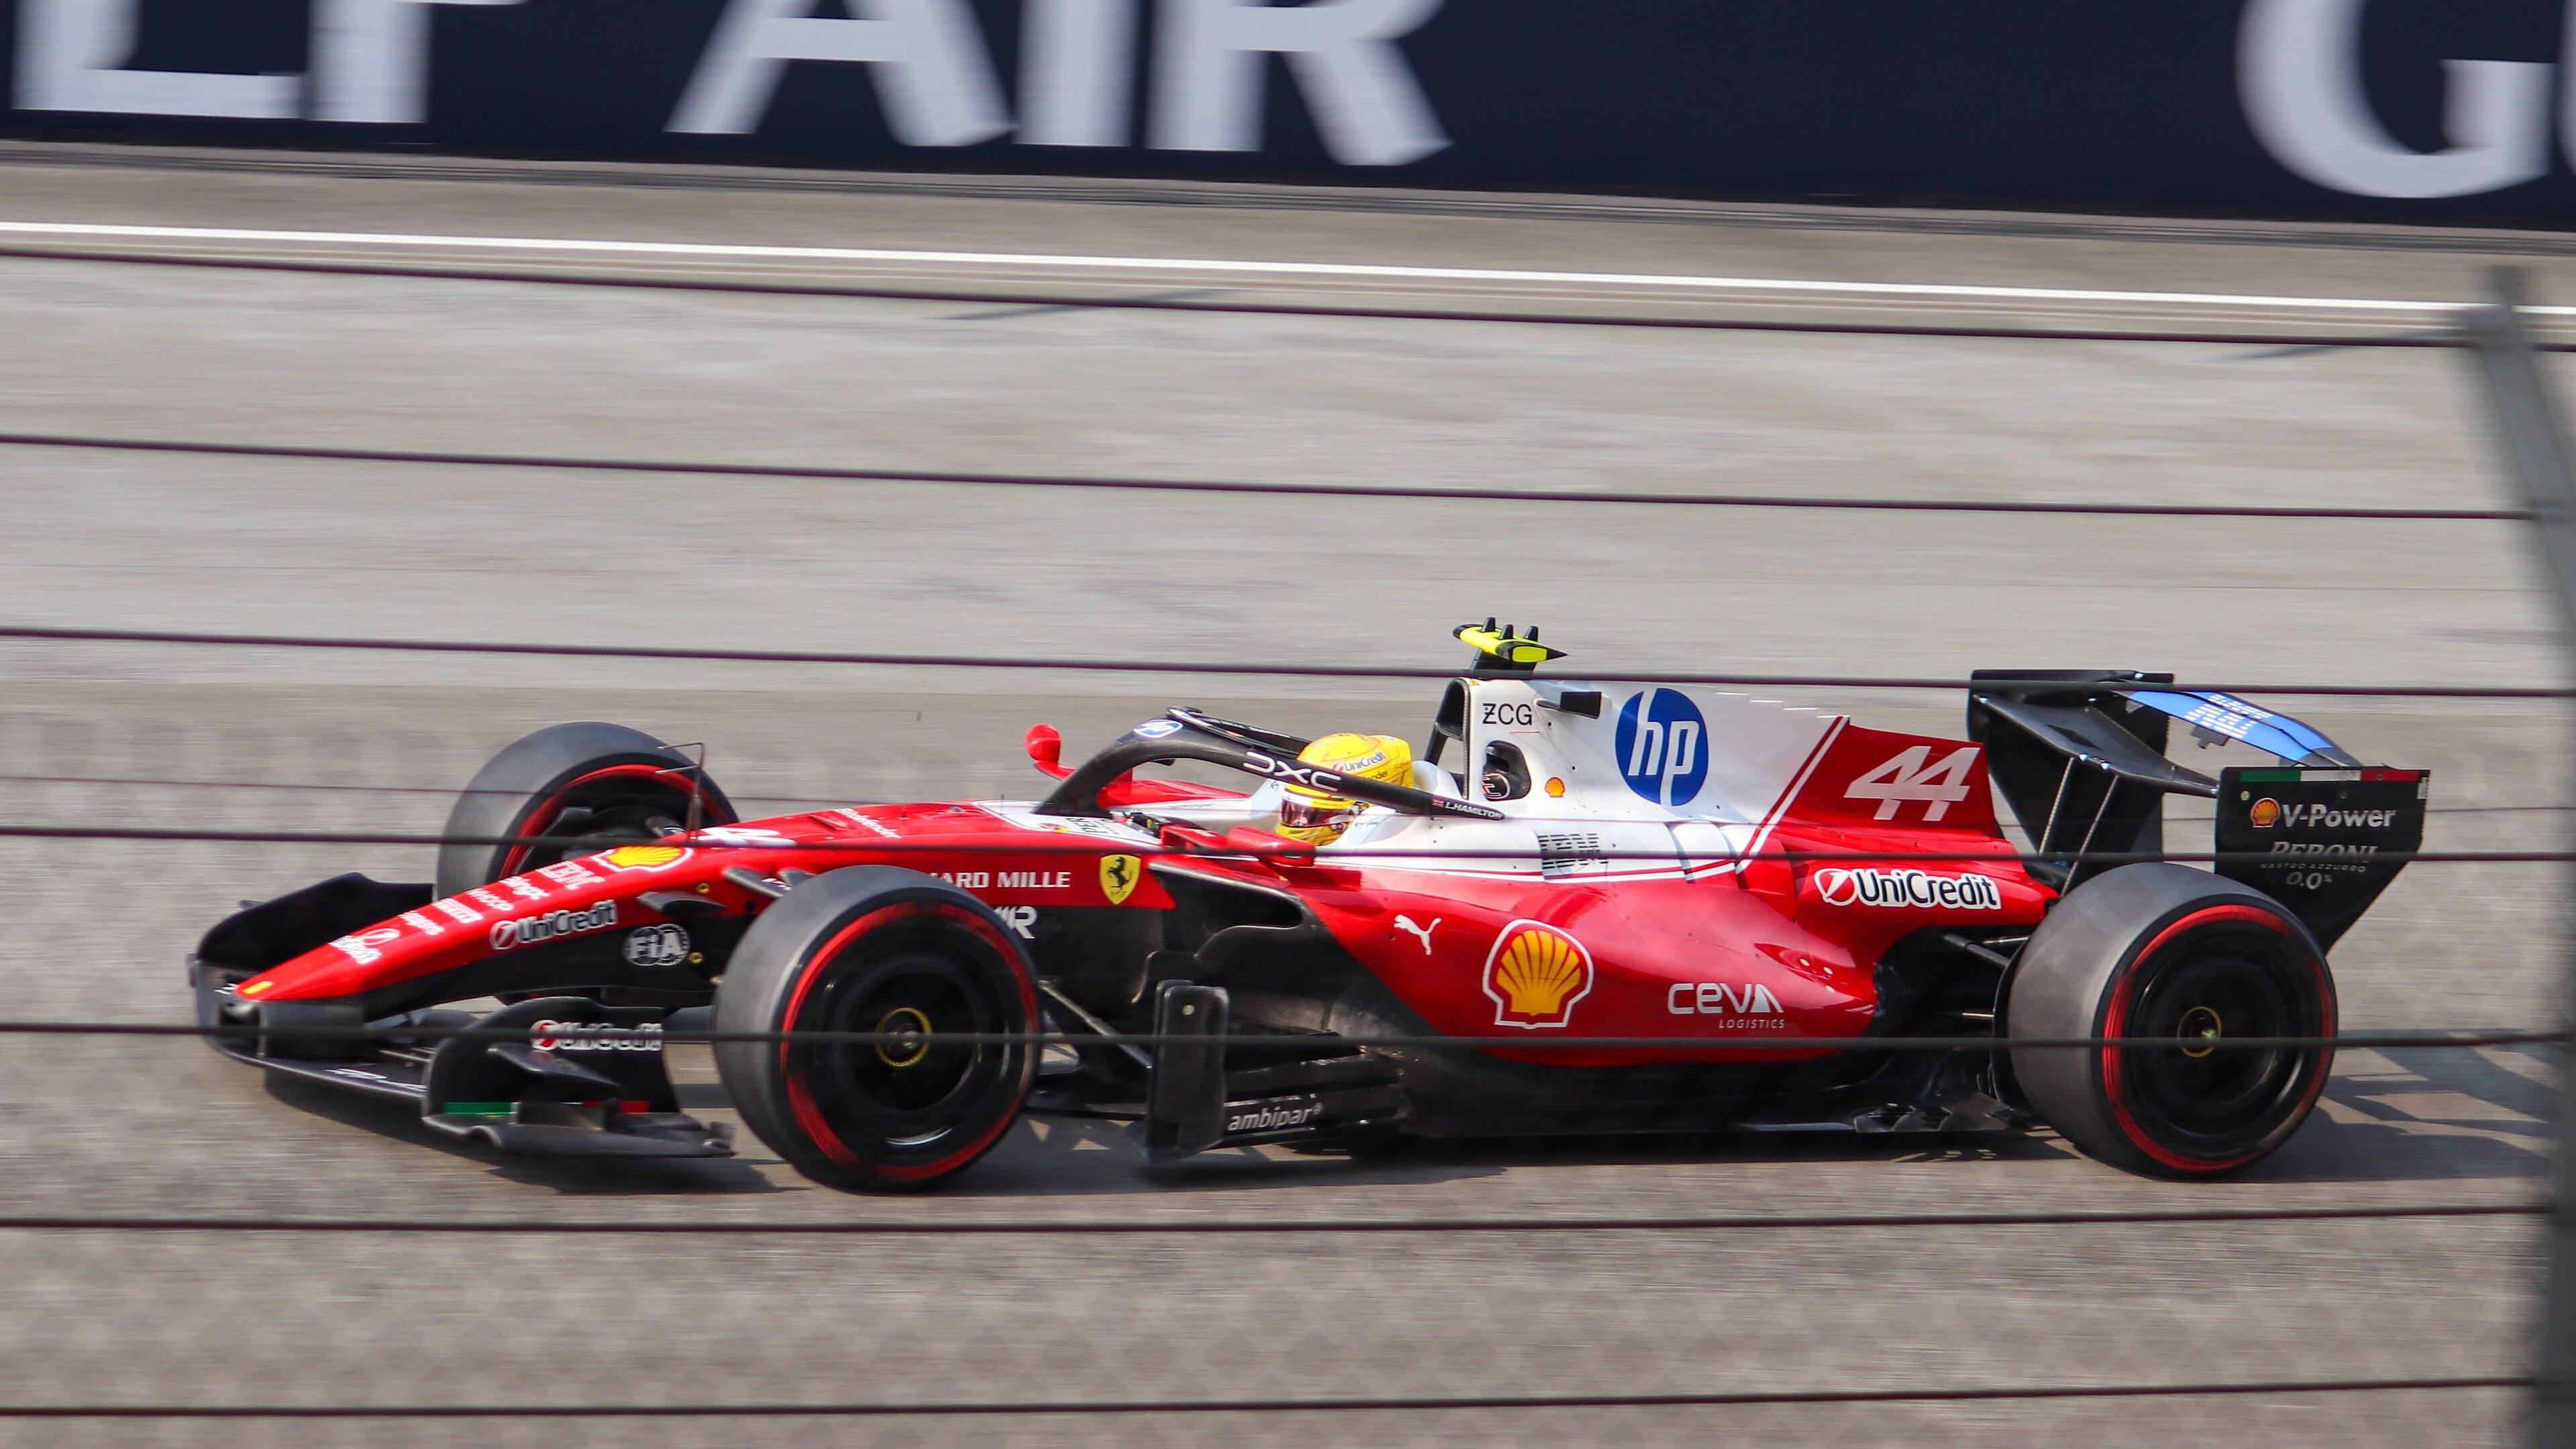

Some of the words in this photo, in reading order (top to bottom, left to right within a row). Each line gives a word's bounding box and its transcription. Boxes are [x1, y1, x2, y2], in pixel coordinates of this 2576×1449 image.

[663, 0, 1456, 166] AIR
[2233, 0, 2576, 200] G
[1626, 688, 1701, 806] hp
[1242, 751, 1342, 792] DXC
[1843, 745, 1981, 822] 44
[2282, 804, 2397, 828] V-Power
[930, 871, 990, 888] ARD
[996, 871, 1072, 888] MILLE
[1854, 870, 1998, 908] UniCredit
[517, 900, 618, 943] UniCredit
[1718, 1018, 1786, 1029] LOGISTICS
